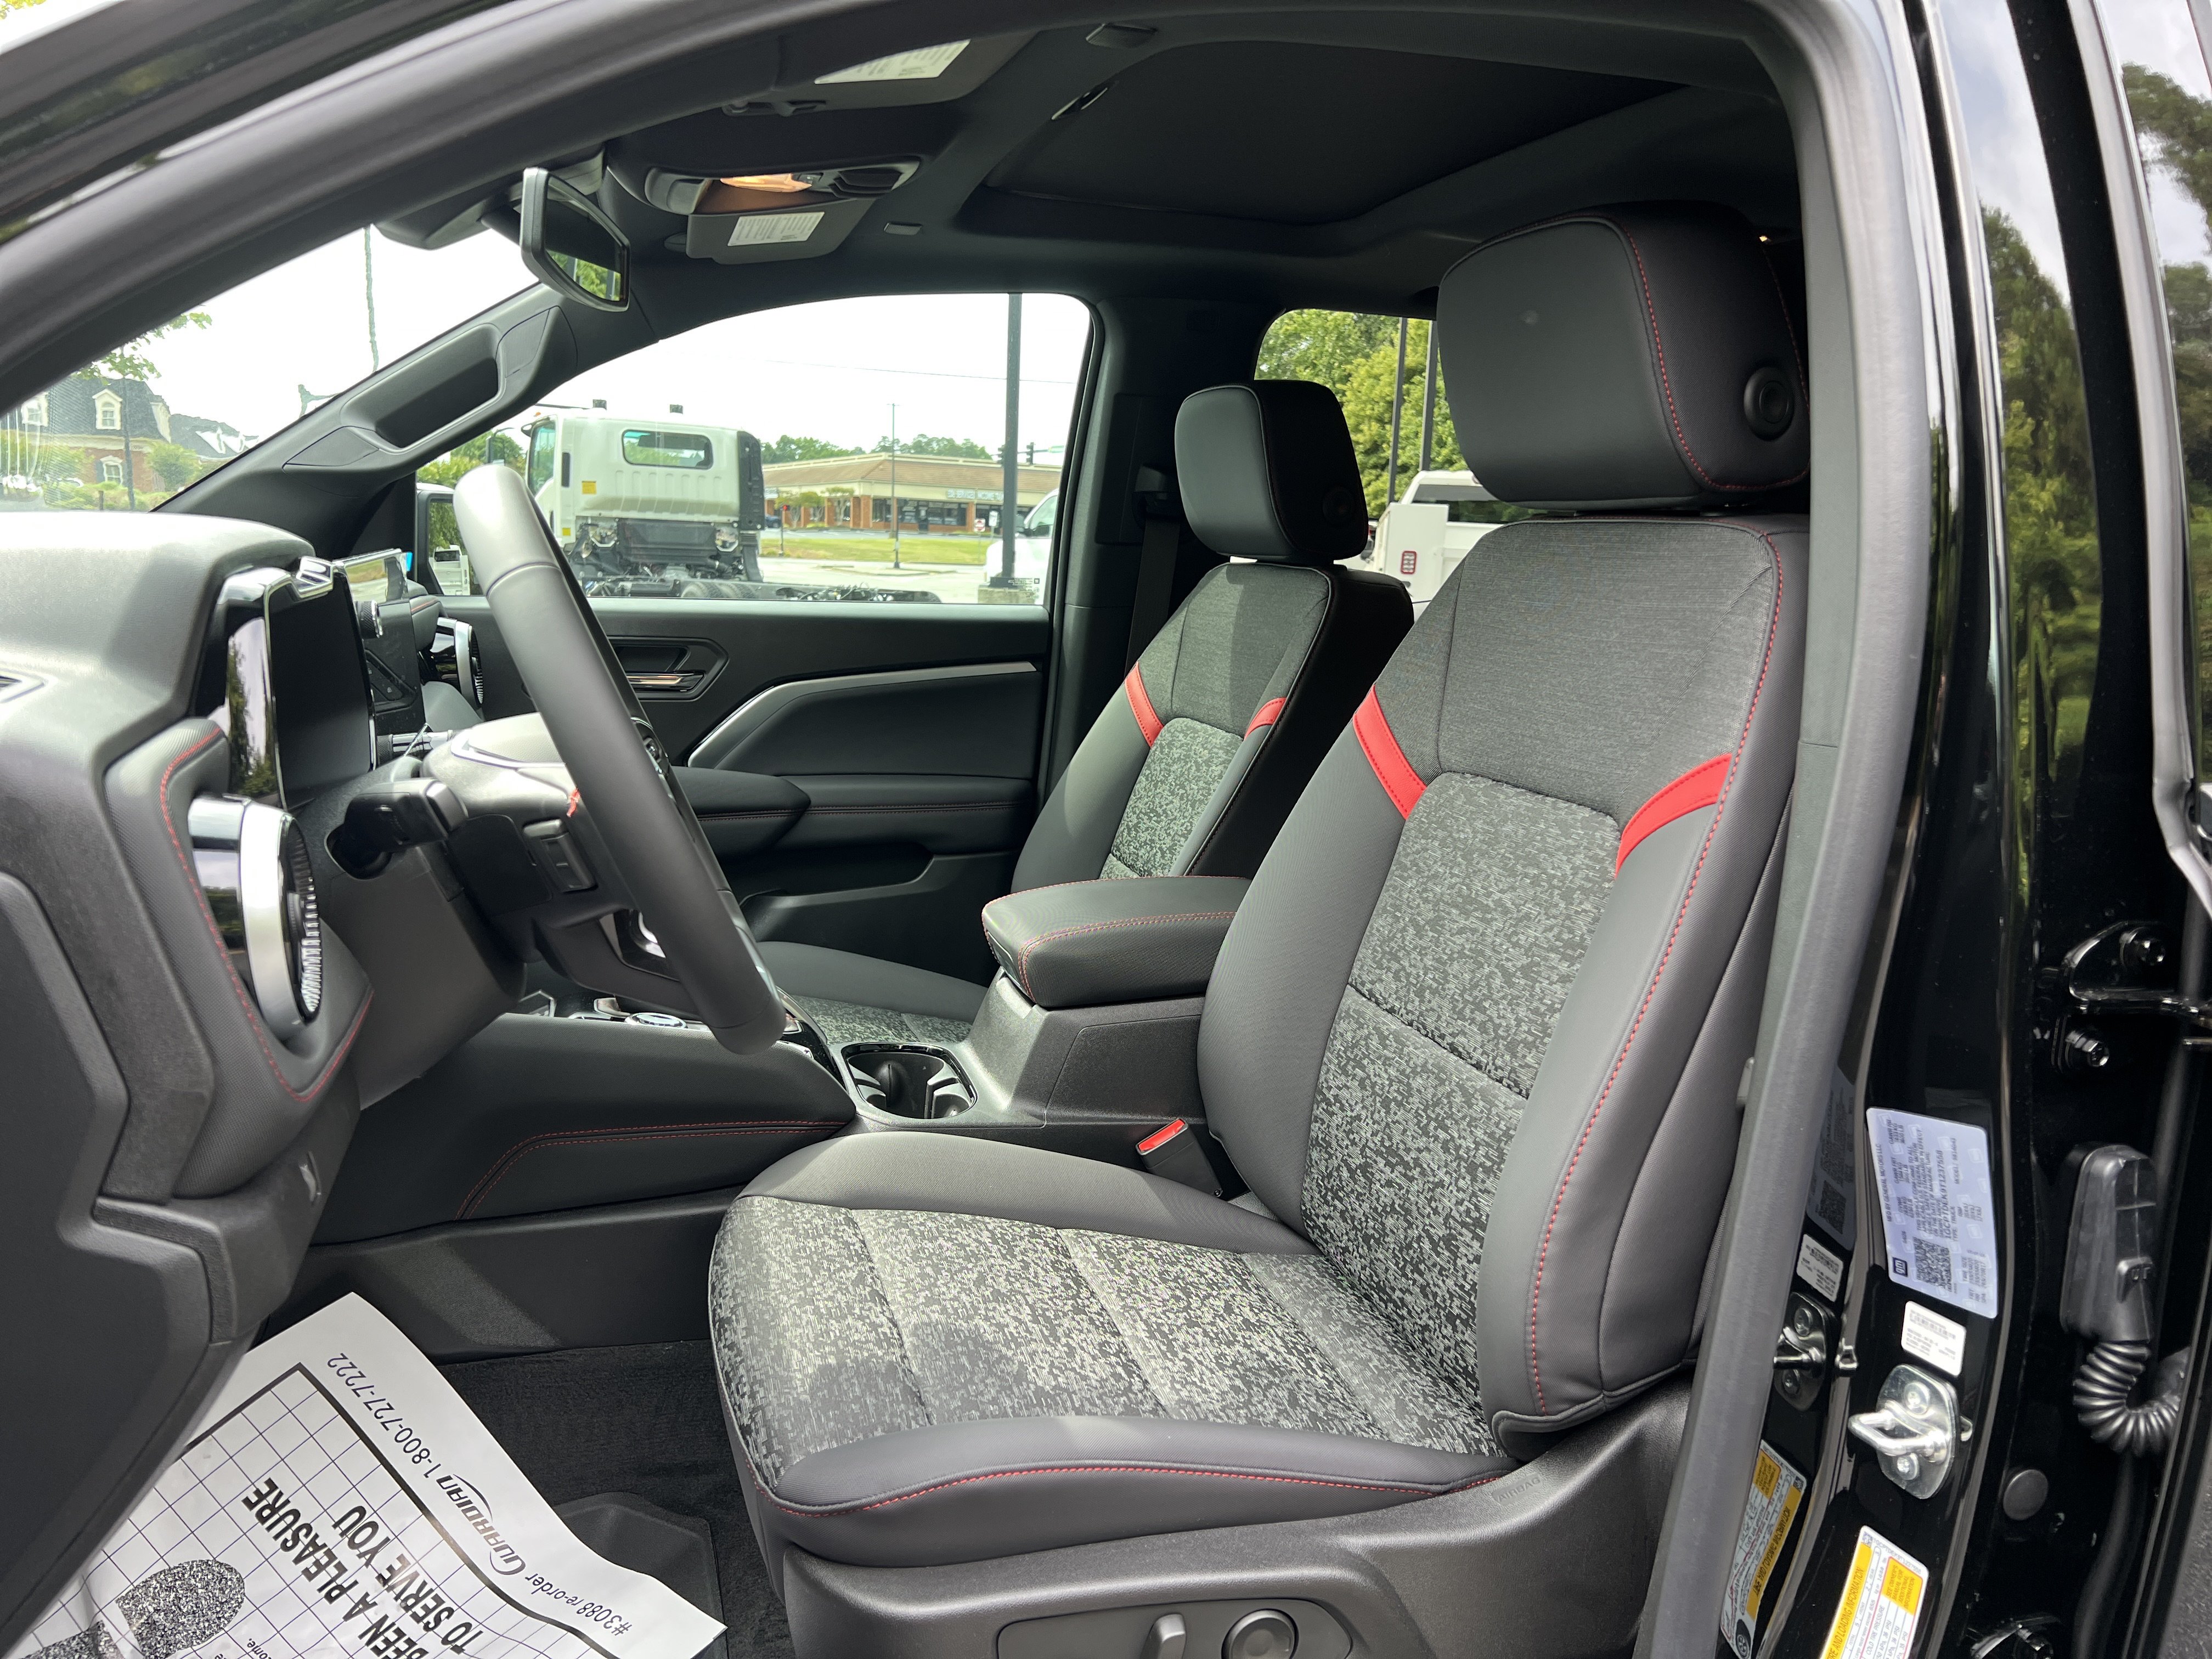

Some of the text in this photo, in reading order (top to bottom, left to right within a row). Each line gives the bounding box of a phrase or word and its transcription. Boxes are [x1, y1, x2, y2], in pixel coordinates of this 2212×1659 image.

[1877, 1154, 1885, 1176] MOTORS
[1908, 1155, 1913, 1164] TO
[1925, 1152, 1933, 1192] MANUFACTURE
[1881, 1178, 1889, 1202] GENERAL
[1933, 1228, 1938, 1237] ON
[1894, 1259, 1906, 1275] gm
[326, 1352, 633, 1636] #3088 re-order GUARDIAN 1-800-727-7222
[1497, 1477, 1541, 1502] AIRBAG
[241, 1477, 359, 1605] PLEASURE
[331, 1505, 483, 1655] TO SERVE YOU
[1847, 1566, 1864, 1610] INFORMATION
[1888, 1564, 1898, 1587] OWNER'S
[1892, 1581, 1900, 1600] MANUAL
[1898, 1574, 1909, 1604] ADDITIONAL
[342, 1591, 379, 1622] A
[1903, 1576, 1915, 1609] INFORMATION
[1837, 1607, 1853, 1638] LOADING
[1865, 1640, 1874, 1656] COLD
[1874, 1604, 1884, 1631] PRESSURE
[1832, 1634, 1843, 1651] AND
